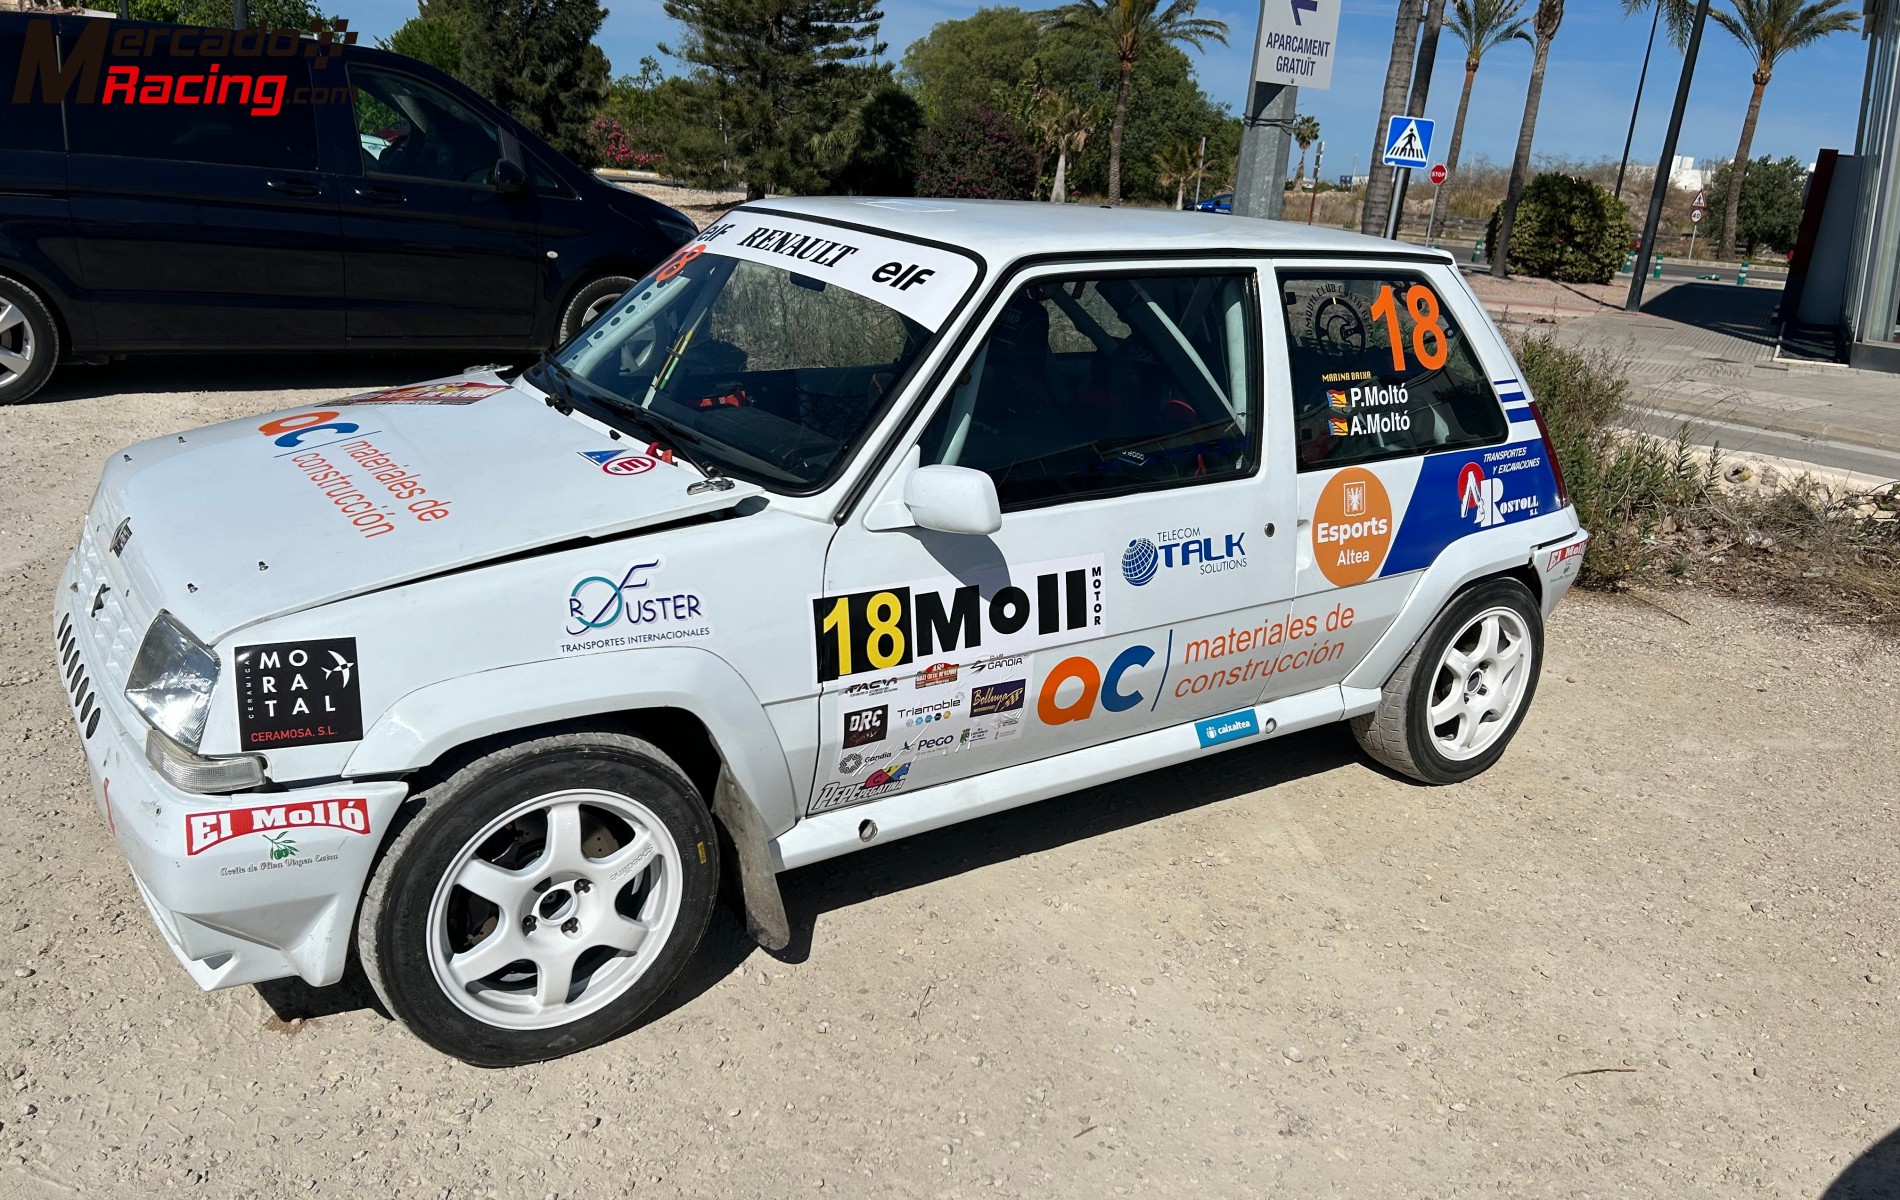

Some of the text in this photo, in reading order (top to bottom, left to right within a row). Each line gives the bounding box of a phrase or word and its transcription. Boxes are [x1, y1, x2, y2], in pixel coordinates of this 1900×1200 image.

[1266, 31, 1331, 57] APARCAMENT
[1276, 55, 1316, 76] GRATUÏT
[697, 223, 936, 291] elf RENAULT elf
[1316, 283, 1336, 297] CLUB
[1370, 285, 1448, 371] 18
[1322, 370, 1371, 383] MARINA BAIXA
[1351, 383, 1409, 408] P.Moltó
[1350, 412, 1411, 437] A.Moltó
[1483, 447, 1528, 463] TRANSPORTES
[1492, 457, 1541, 476] Y EXCAVACIONES
[340, 440, 450, 522] materiales de
[291, 452, 395, 539] construcción
[1157, 527, 1201, 543] TELECOM
[1317, 516, 1388, 546] Esports
[1158, 532, 1246, 568] TALK
[1337, 550, 1370, 568] Altea
[1200, 557, 1248, 576] SOLUTIONS
[1091, 565, 1102, 627] MOTOR
[823, 568, 1088, 677] 18 Moll
[1184, 602, 1355, 665] materiales de
[561, 627, 710, 653] TRANSPORTES INTERNACIONALES
[1174, 639, 1345, 698] construcción
[1037, 644, 1156, 726] ac
[898, 698, 961, 719] Triamoble
[1217, 718, 1251, 736] caixaltea
[864, 751, 892, 764] Gandia
[811, 781, 866, 811] PEPE
[191, 800, 366, 853] El Molló
[220, 866, 246, 876] Aceite
[247, 863, 258, 873] de
